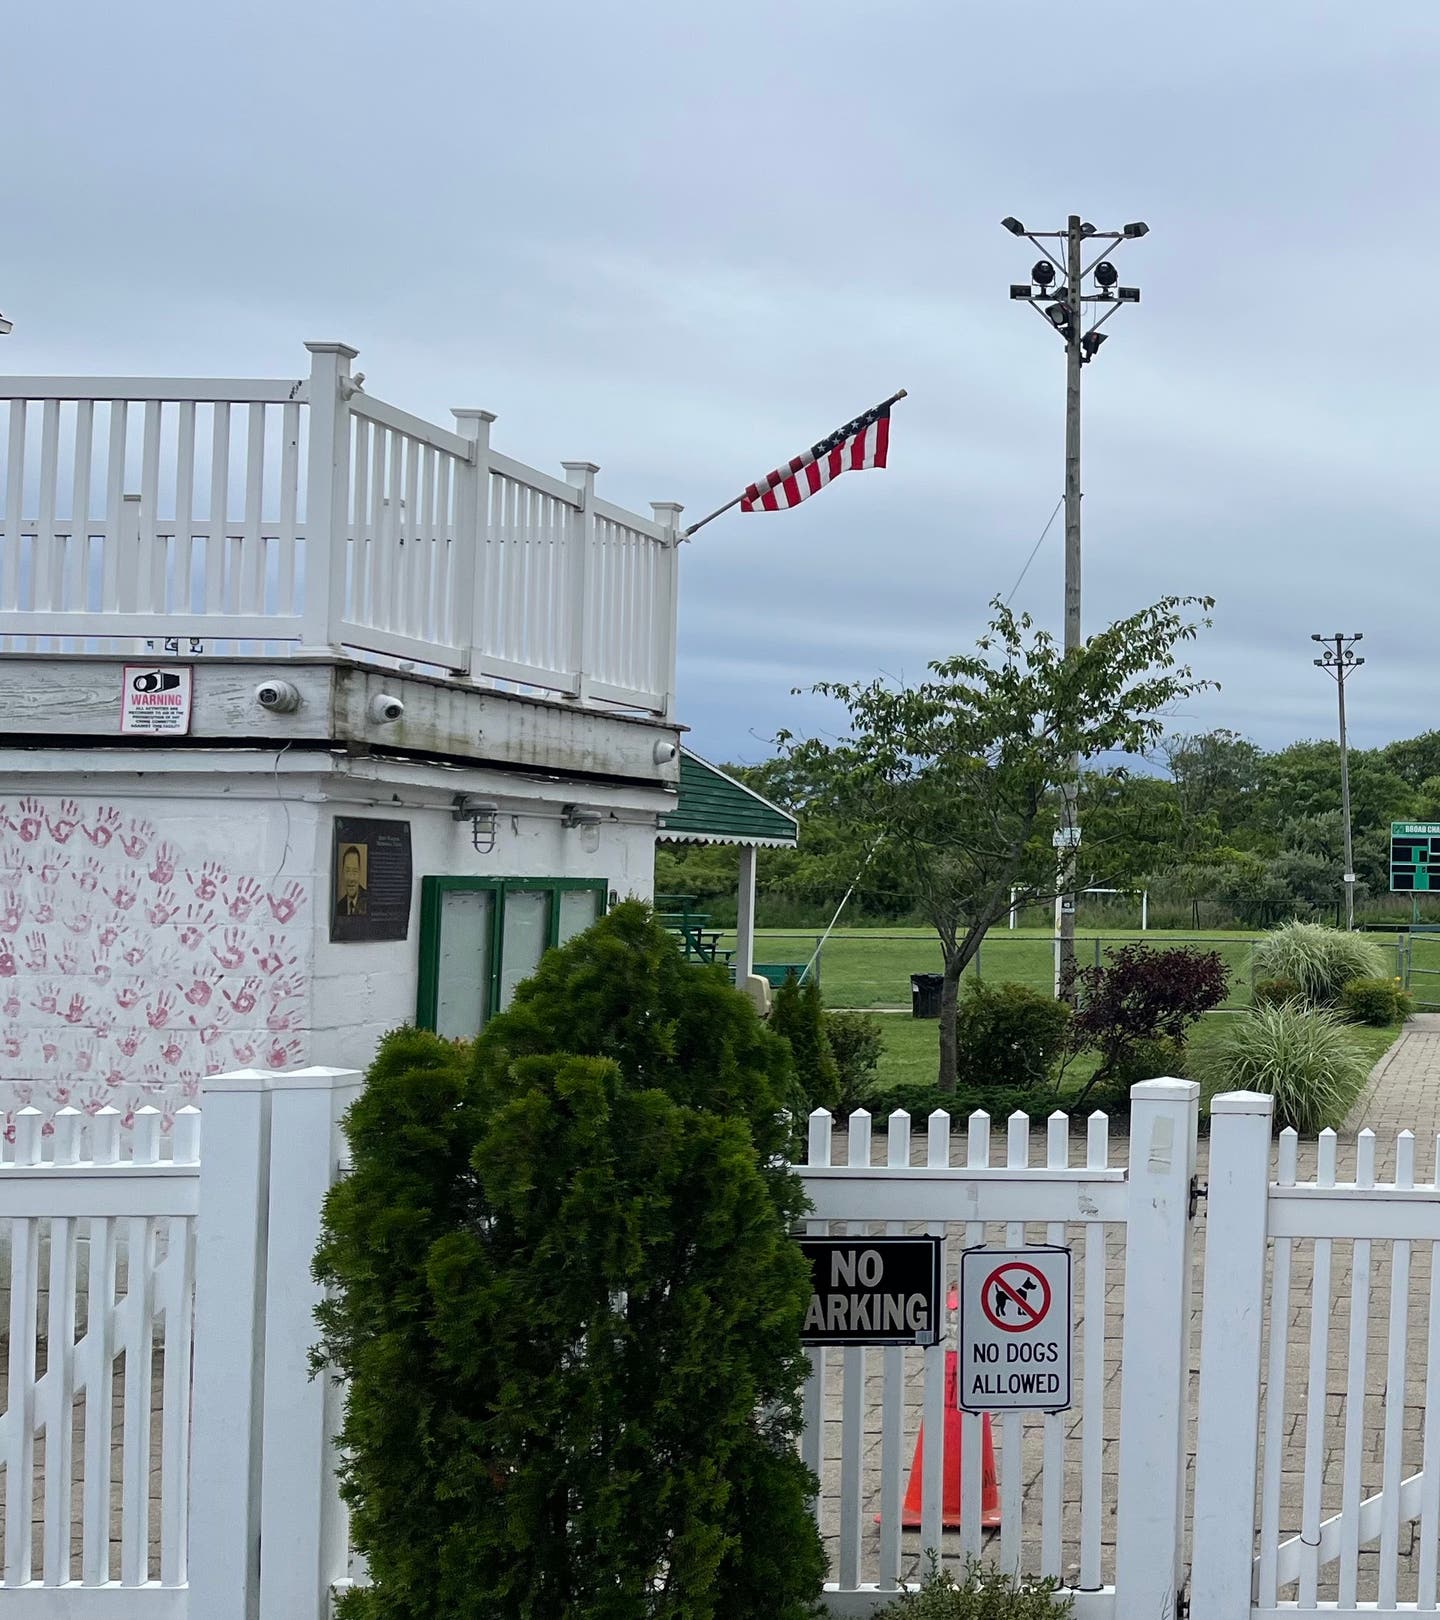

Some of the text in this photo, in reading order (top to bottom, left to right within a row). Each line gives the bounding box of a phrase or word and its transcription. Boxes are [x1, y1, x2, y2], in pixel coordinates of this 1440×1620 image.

[131, 694, 182, 705] WARNING
[830, 1250, 884, 1288] NO
[804, 1293, 928, 1331] ARKING
[973, 1342, 1058, 1363] NO DOGS
[972, 1373, 1060, 1394] ALLOWED
